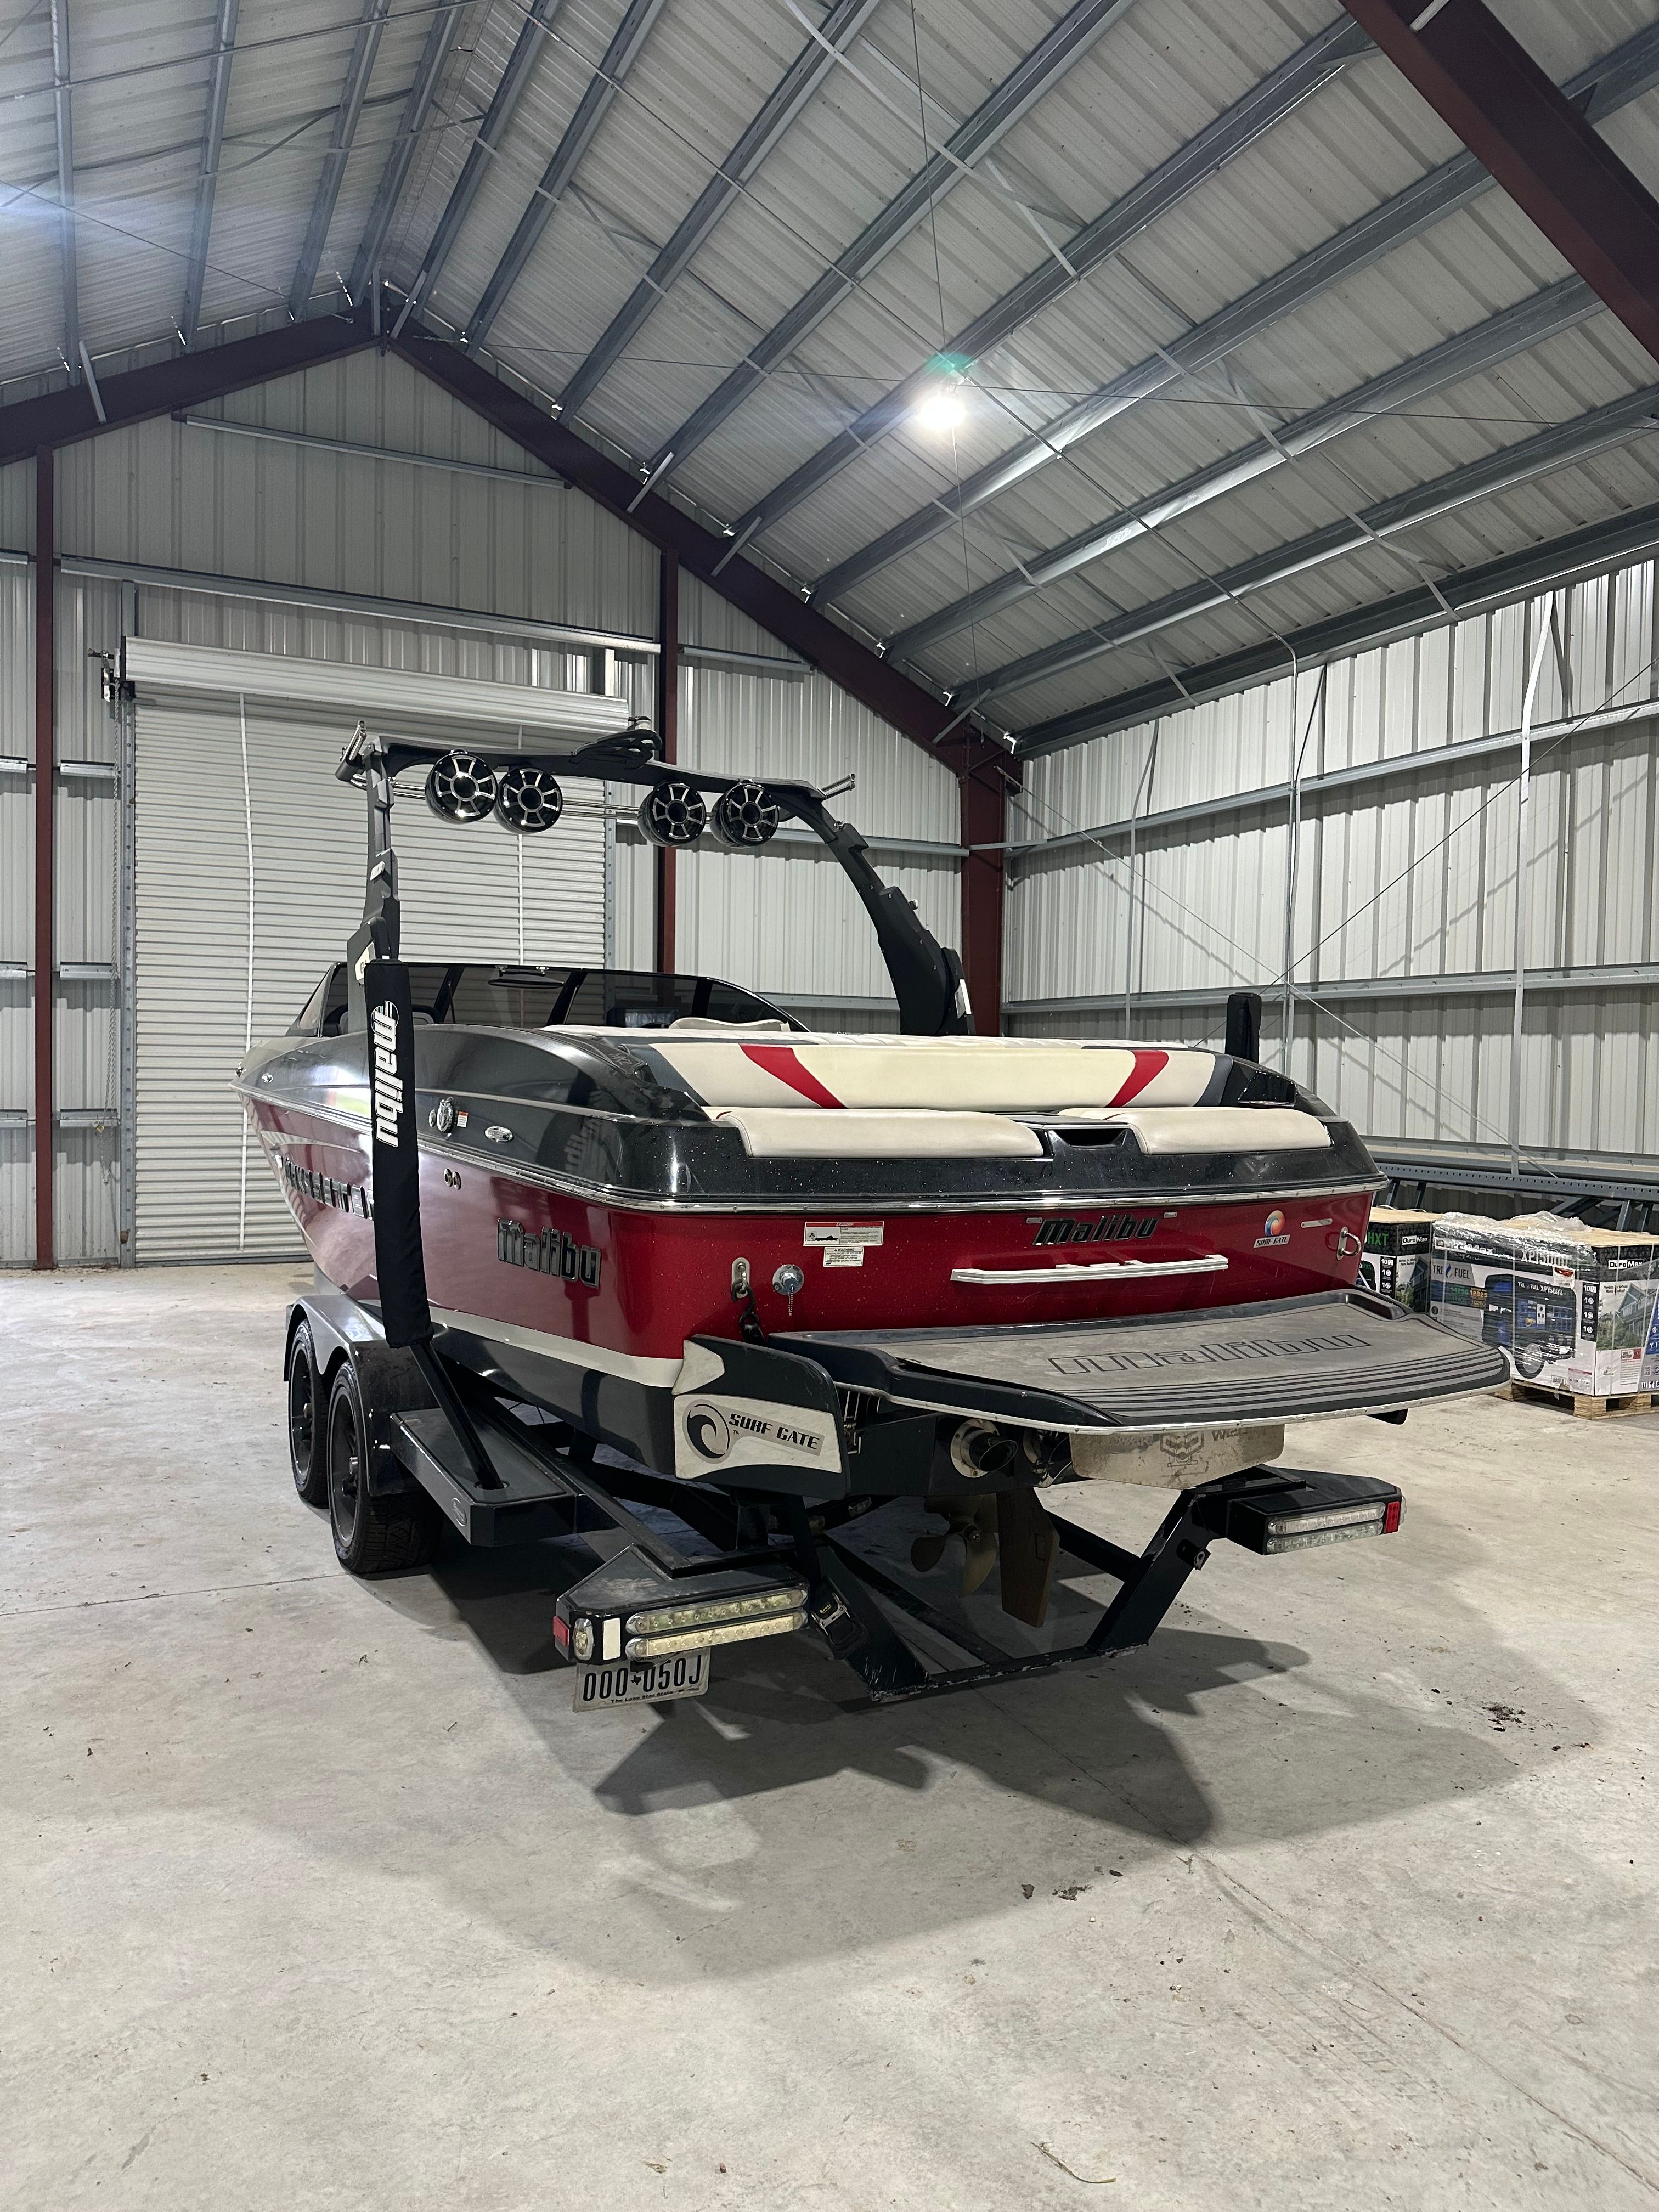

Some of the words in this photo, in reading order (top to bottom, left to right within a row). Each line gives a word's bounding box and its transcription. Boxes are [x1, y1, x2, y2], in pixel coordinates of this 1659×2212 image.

[374, 1011, 403, 1148] malibu
[1256, 1238, 1272, 1247] SURF
[1273, 1236, 1289, 1244] GATE
[1432, 1265, 1443, 1275] TRI
[1454, 1268, 1470, 1279] FUEL
[1047, 1334, 1372, 1375] malibu
[729, 1413, 773, 1434] SURF
[776, 1427, 820, 1450] GATE
